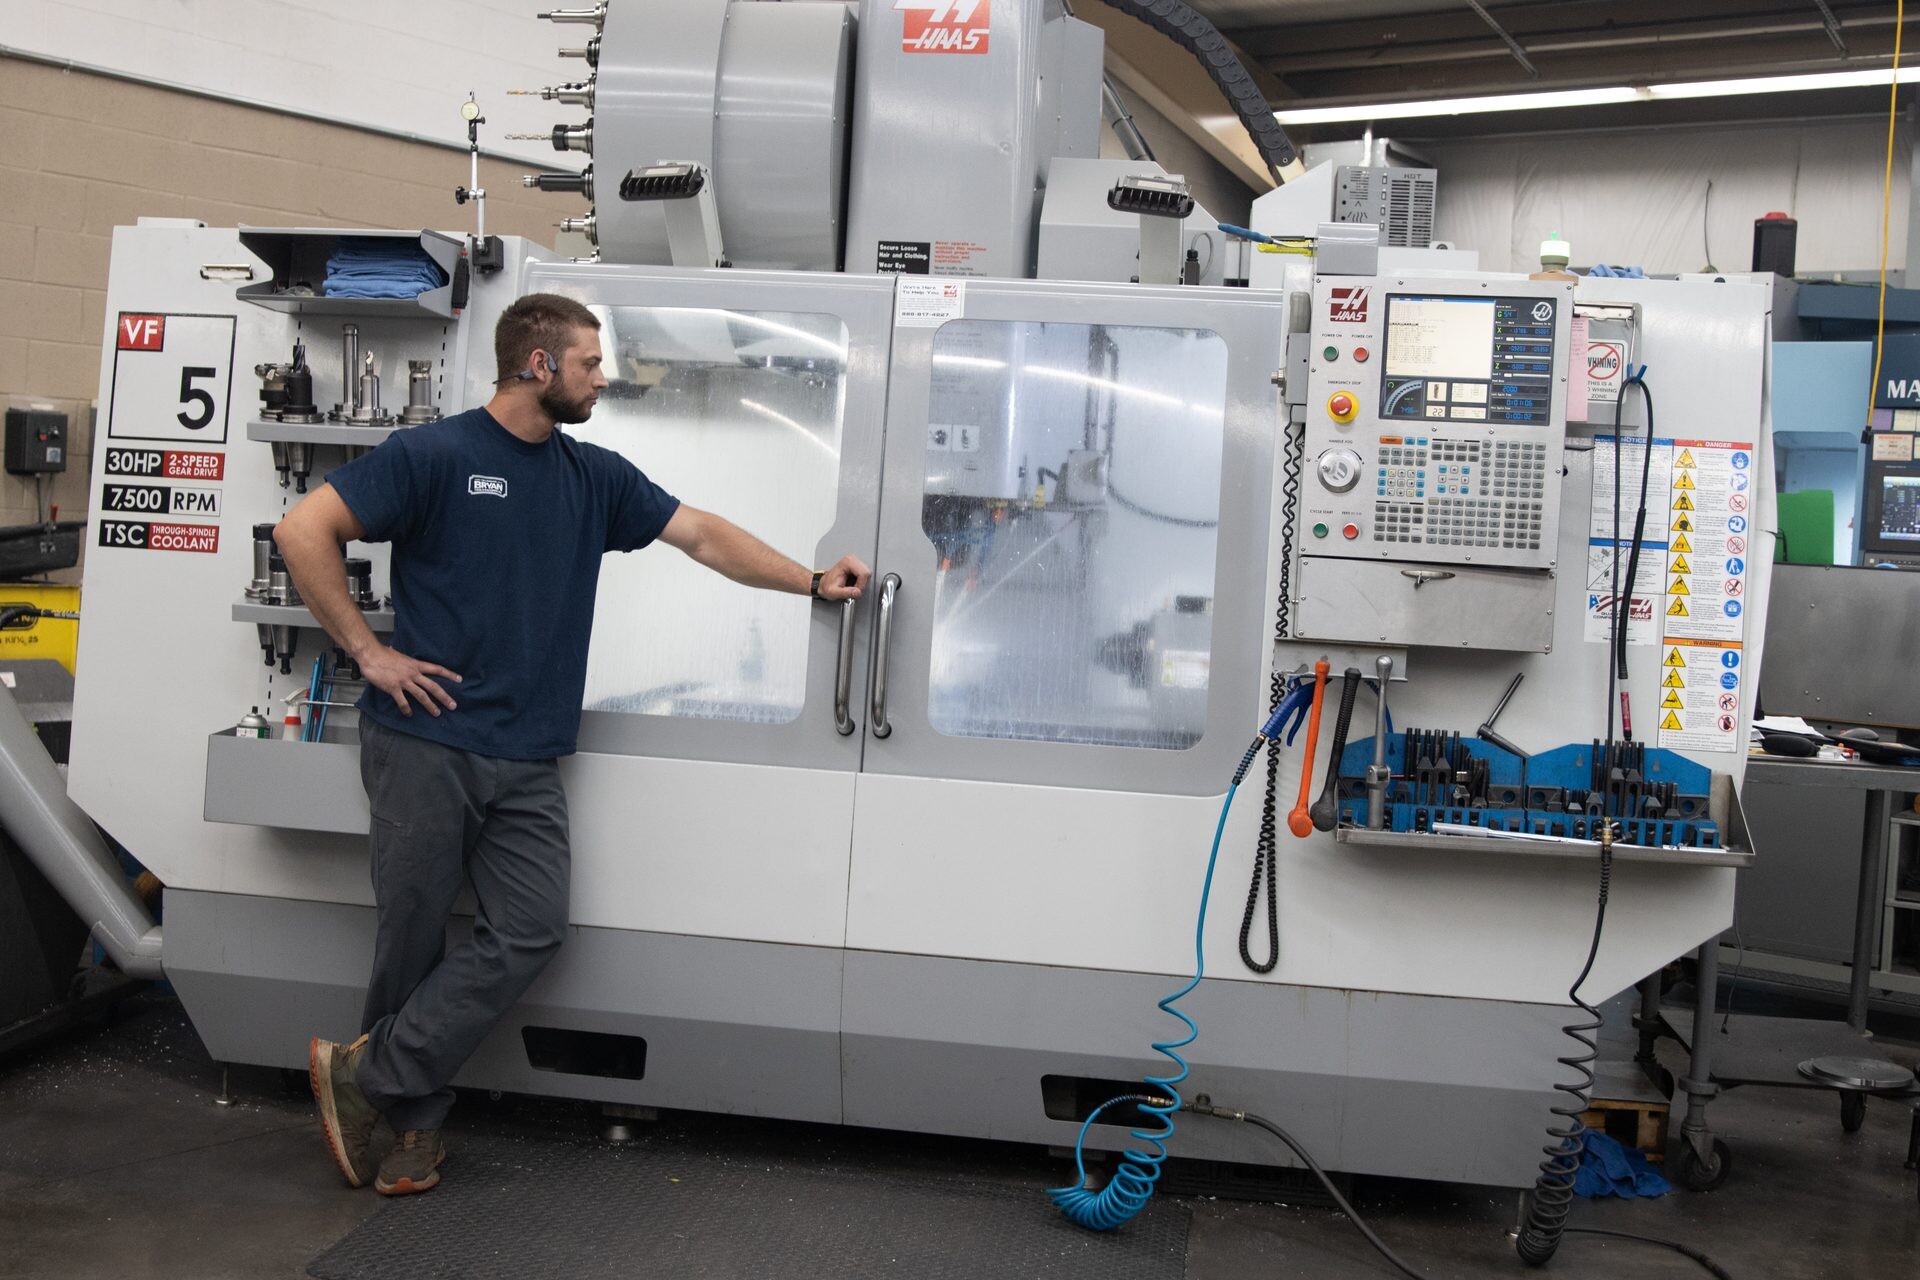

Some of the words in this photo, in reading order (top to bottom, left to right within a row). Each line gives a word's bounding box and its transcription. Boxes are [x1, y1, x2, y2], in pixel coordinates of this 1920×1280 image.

[903, 27, 990, 50] HAAS
[1331, 311, 1367, 321] HAAS
[125, 319, 159, 345] VF
[177, 366, 216, 430] 5
[108, 451, 162, 473] 30HP
[169, 454, 218, 468] 2-SPEED
[168, 467, 191, 476] GEAR
[193, 467, 218, 477] DRIVE
[474, 480, 503, 491] BRYAN
[111, 487, 162, 510] 7,500
[173, 492, 216, 512] RPM
[105, 523, 145, 545] TSC
[152, 525, 216, 537] THROUGH-SPINDLE
[151, 535, 215, 550] COOLANT
